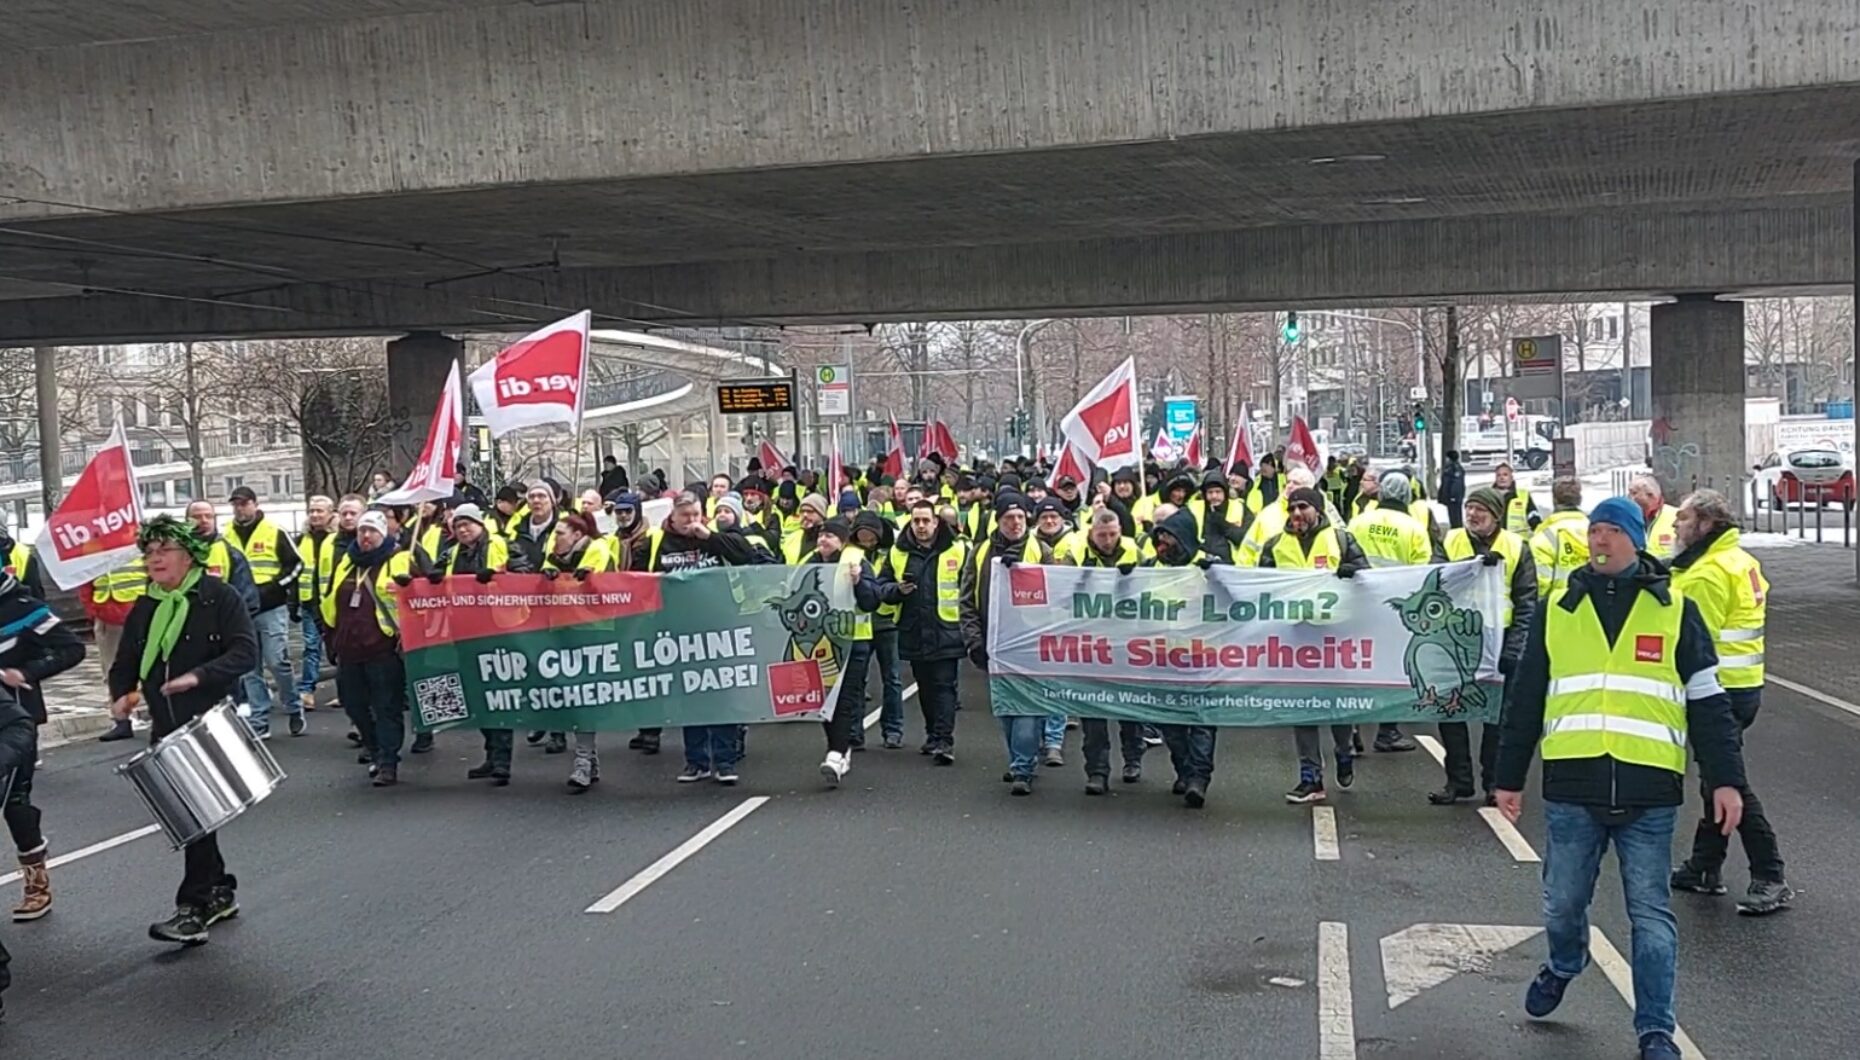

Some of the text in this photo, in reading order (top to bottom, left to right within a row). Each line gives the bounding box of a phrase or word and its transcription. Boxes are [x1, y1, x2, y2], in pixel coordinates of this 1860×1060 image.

[1521, 343, 1532, 355] H
[1369, 524, 1398, 537] BEWA
[408, 592, 632, 609] WACH- UND SICHERHEITSDIENSTE NRW
[1073, 591, 1339, 622] Mehr Lohn?
[477, 626, 755, 682] FÜR GUTE LÖHNE
[1040, 635, 1373, 668] Mit Sicherheit!
[485, 688, 522, 711] MIT
[529, 673, 673, 711] SICHERHEIT
[1042, 688, 1373, 710] Tarifrunde Wach- & Sicherheitsgewerbe NRW
